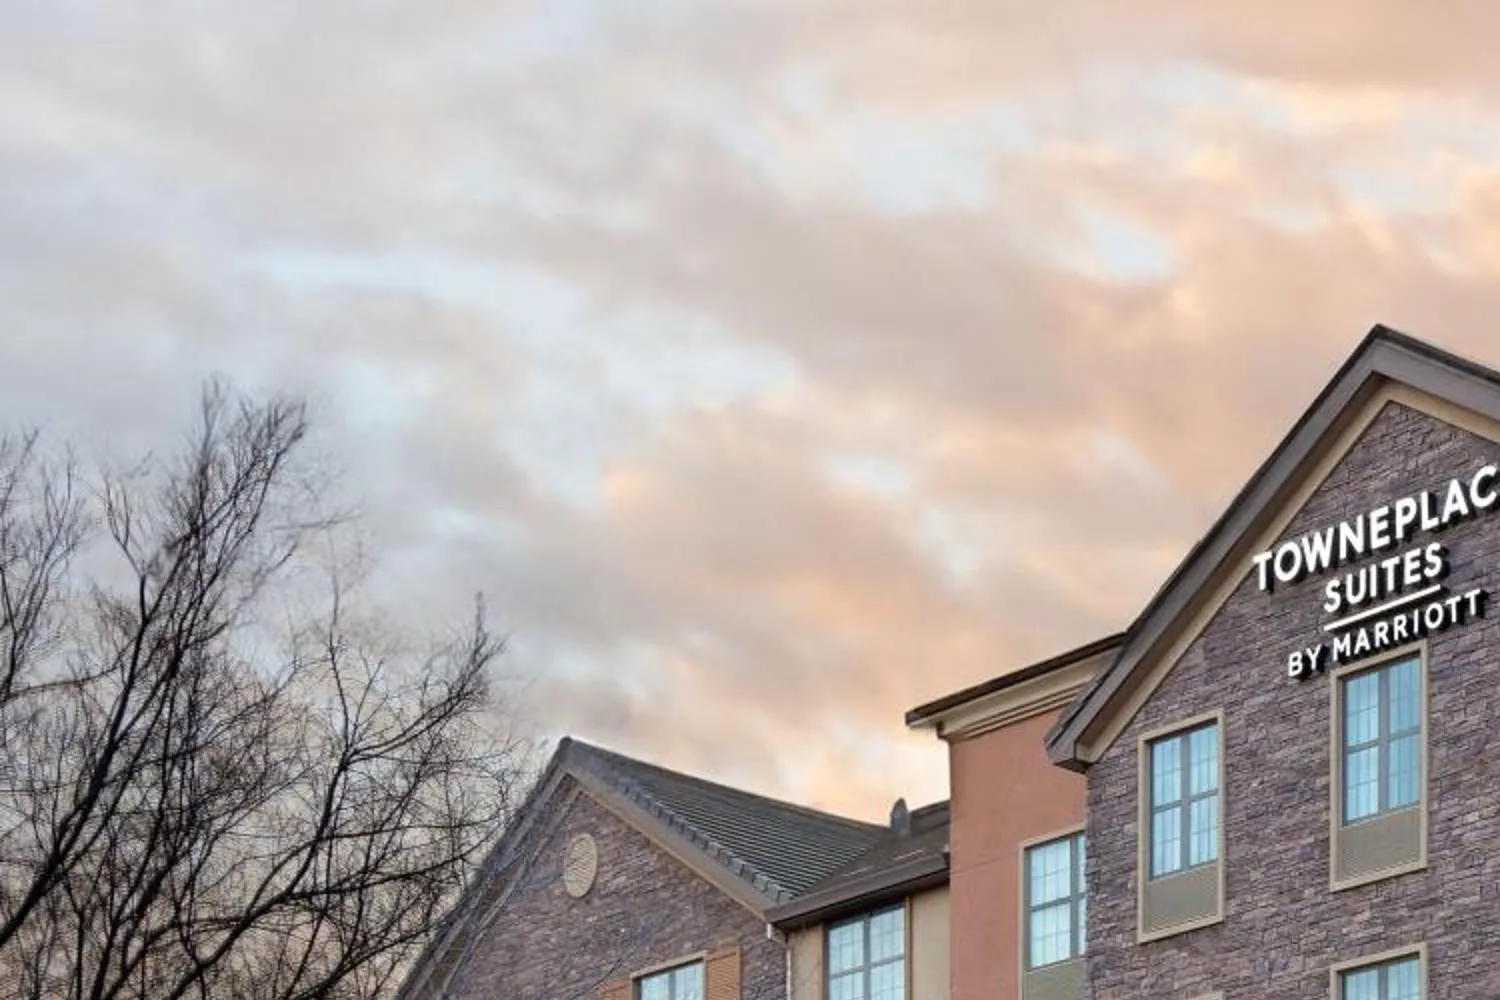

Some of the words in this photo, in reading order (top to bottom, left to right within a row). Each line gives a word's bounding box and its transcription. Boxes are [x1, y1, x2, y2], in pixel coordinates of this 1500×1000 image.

[1323, 542, 1442, 613] SUITES
[1288, 645, 1322, 677] BY
[1333, 589, 1481, 662] MARRIOTT
